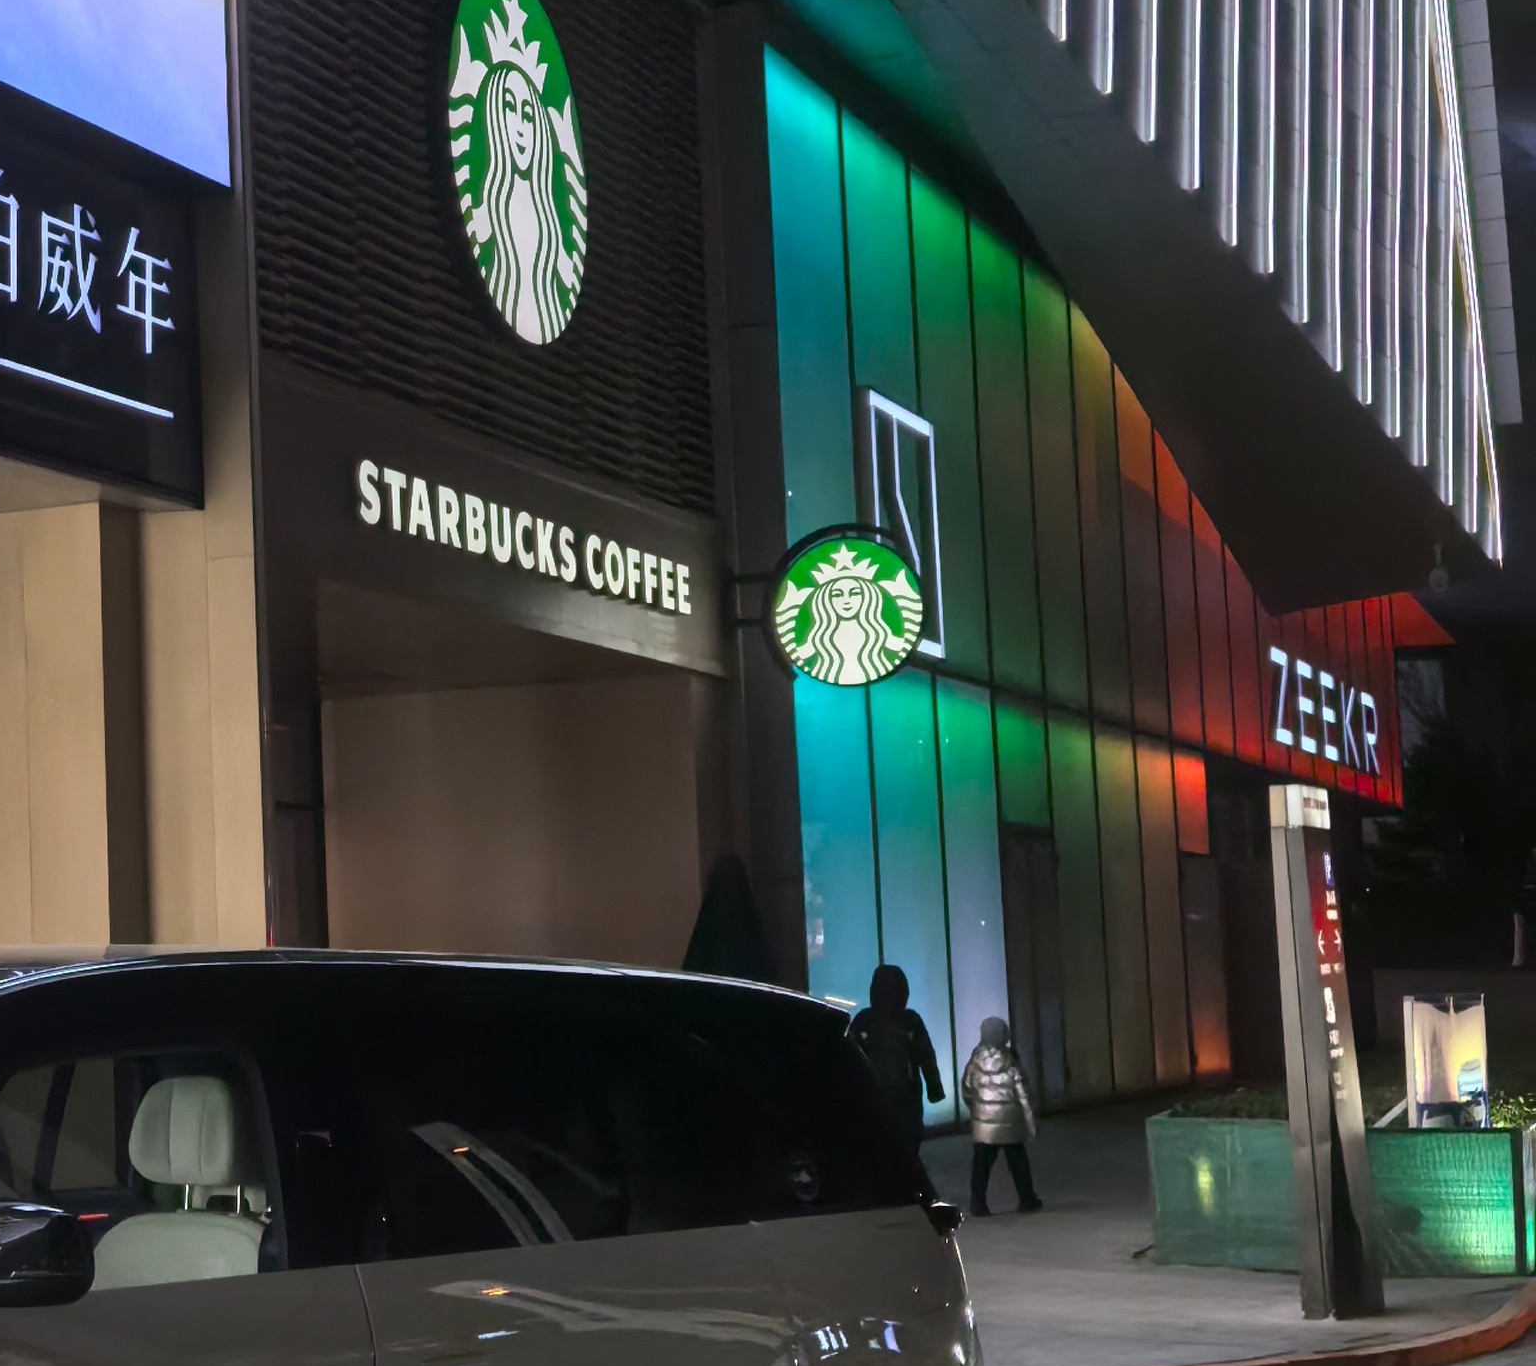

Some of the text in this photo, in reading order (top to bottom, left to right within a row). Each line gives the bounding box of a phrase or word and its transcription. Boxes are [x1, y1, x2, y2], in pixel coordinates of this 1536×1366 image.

[358, 459, 692, 615] STARBUCKS COFFEE
[1270, 646, 1380, 775] ZEEKR
